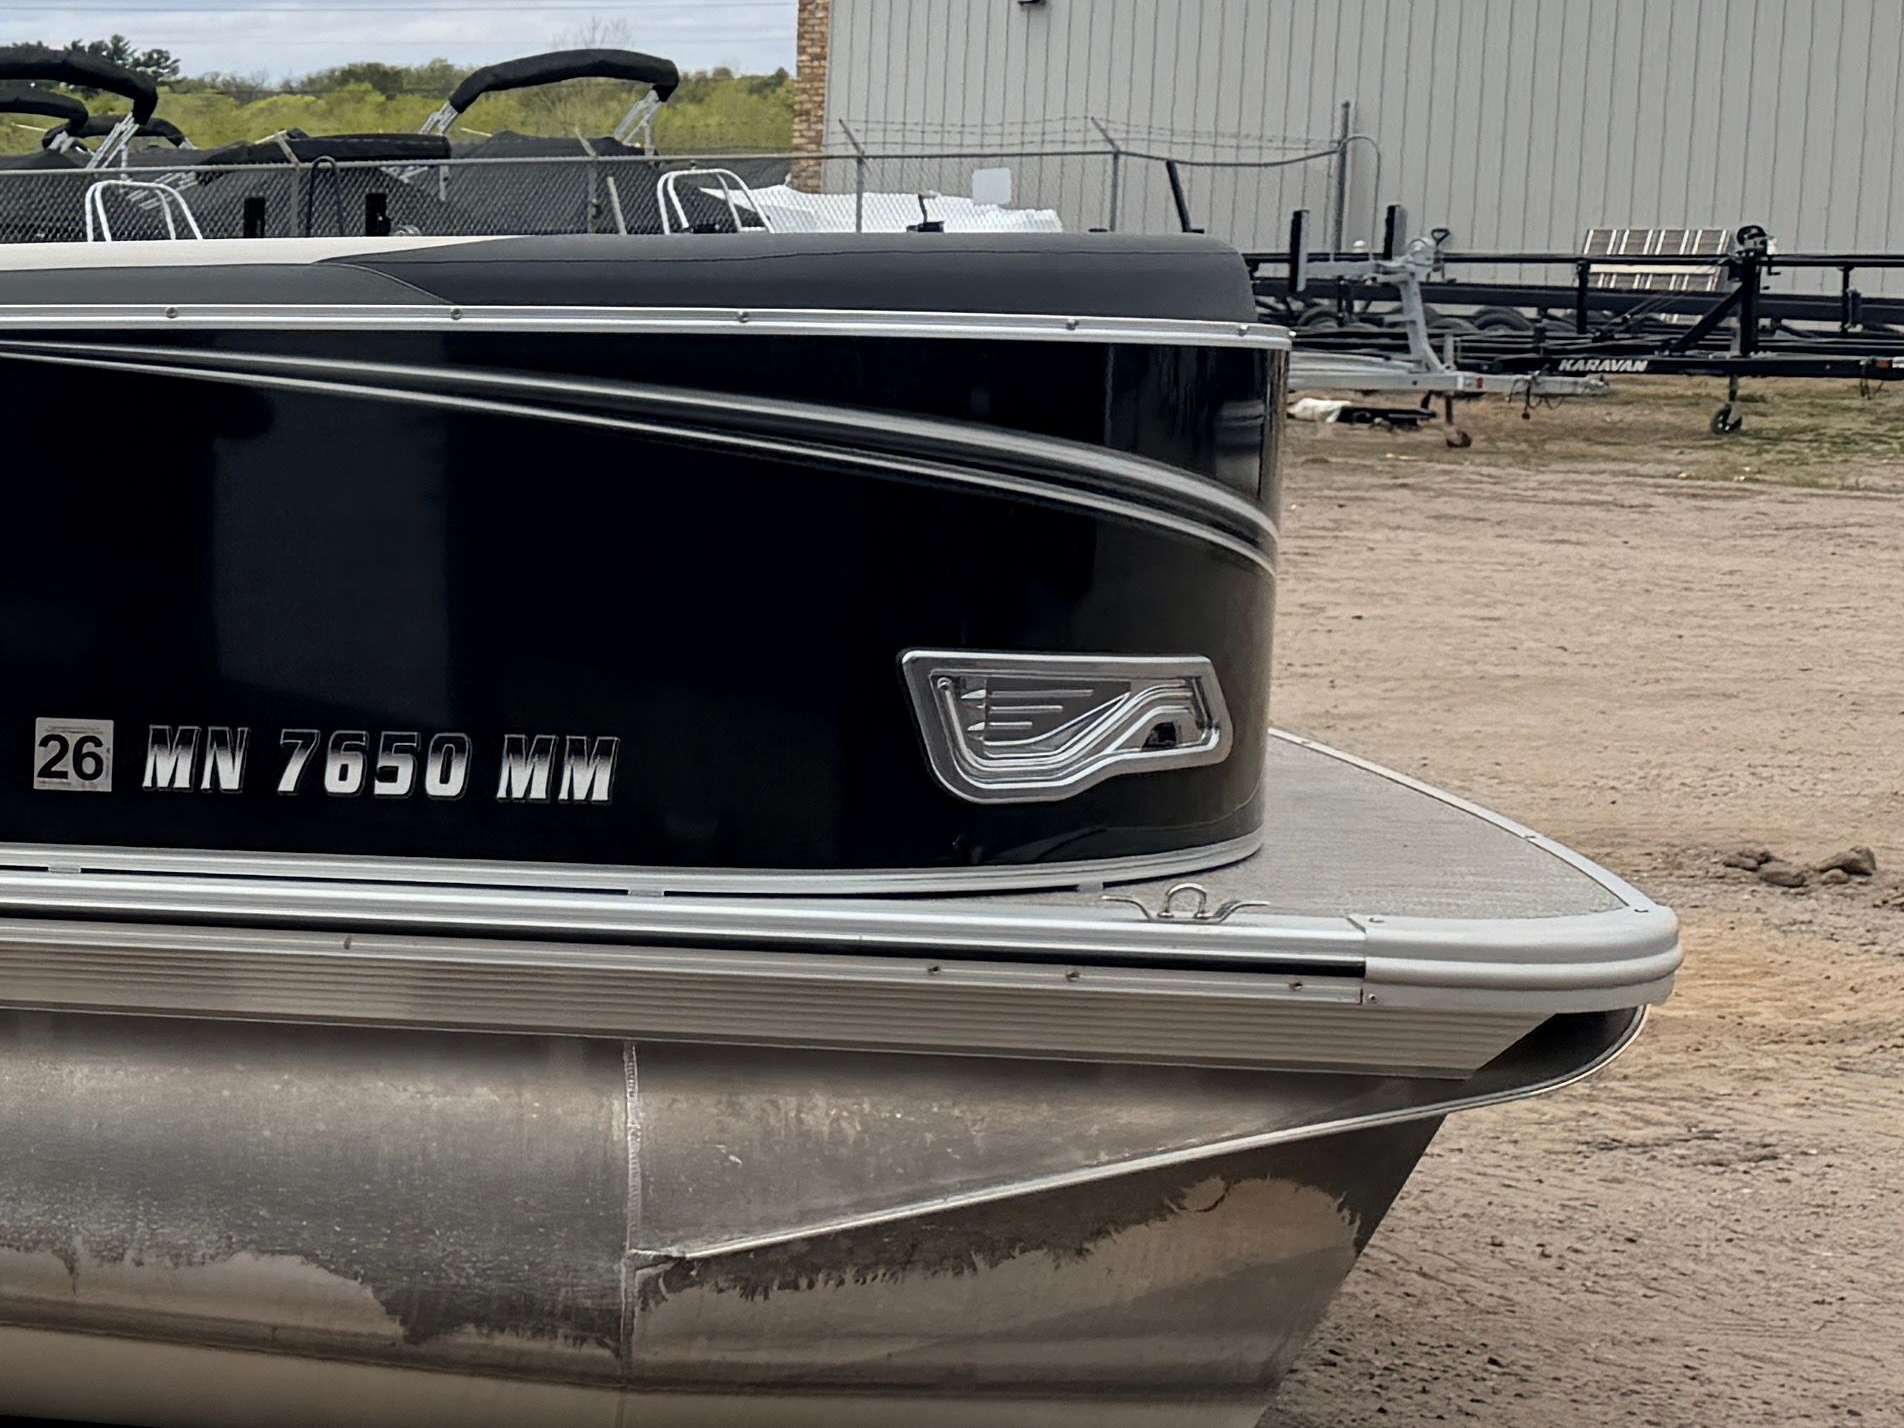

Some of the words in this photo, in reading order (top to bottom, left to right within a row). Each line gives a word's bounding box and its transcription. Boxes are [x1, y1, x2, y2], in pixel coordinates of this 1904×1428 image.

[1558, 359, 1648, 372] KARAVAN
[37, 734, 104, 781] 26
[141, 724, 252, 794] MN
[277, 729, 473, 800] 7650
[496, 734, 620, 804] MM
